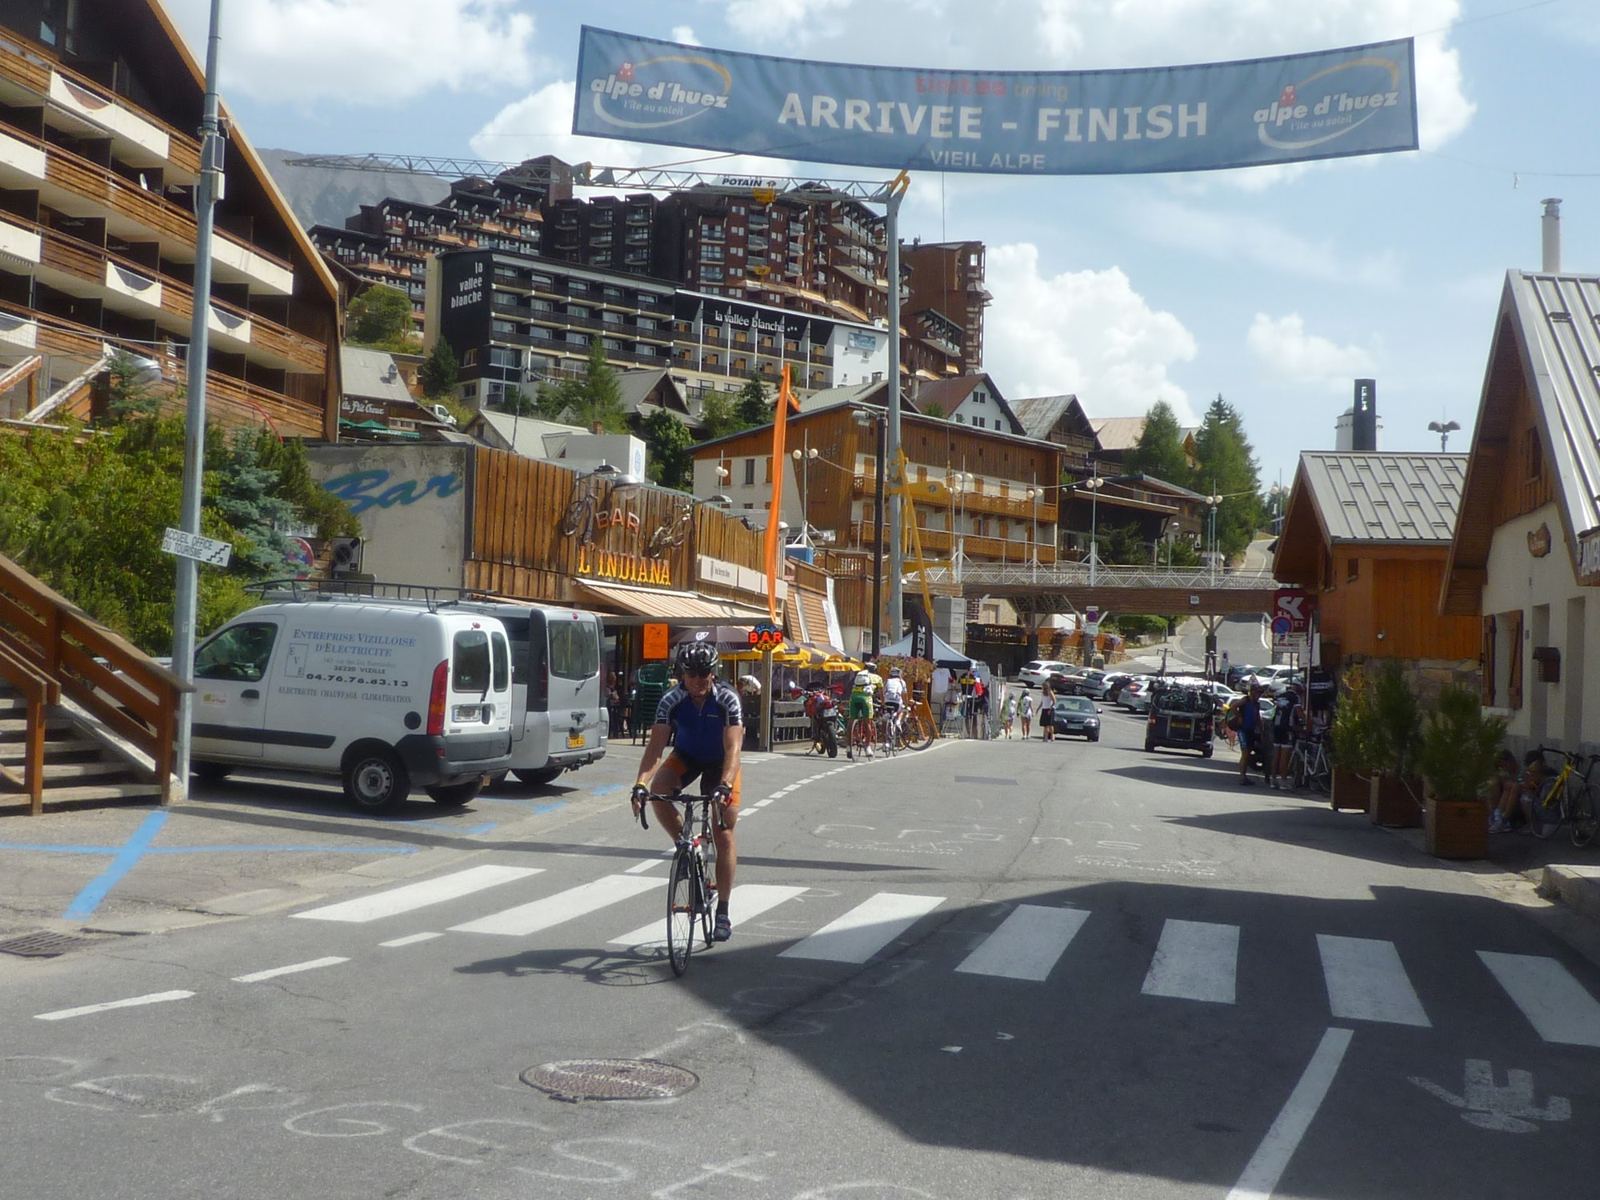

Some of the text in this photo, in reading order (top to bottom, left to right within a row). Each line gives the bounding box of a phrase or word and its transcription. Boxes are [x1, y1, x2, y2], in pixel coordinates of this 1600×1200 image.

[591, 74, 729, 109] alpe d'huez
[778, 92, 983, 139] ARRIVEE
[1038, 102, 1207, 142] FINISH
[1254, 91, 1399, 126] alpe d'huez
[930, 149, 1046, 170] VIEIL ALPE
[722, 177, 763, 187] POTAIN
[475, 261, 483, 274] la
[450, 291, 482, 309] blanche
[715, 310, 723, 322] la
[752, 313, 785, 333] blanche
[325, 469, 463, 515] Bar
[595, 508, 640, 536] BAR
[578, 542, 672, 586] L'INDIANA
[749, 631, 783, 644] BAR
[916, 624, 926, 658] REK
